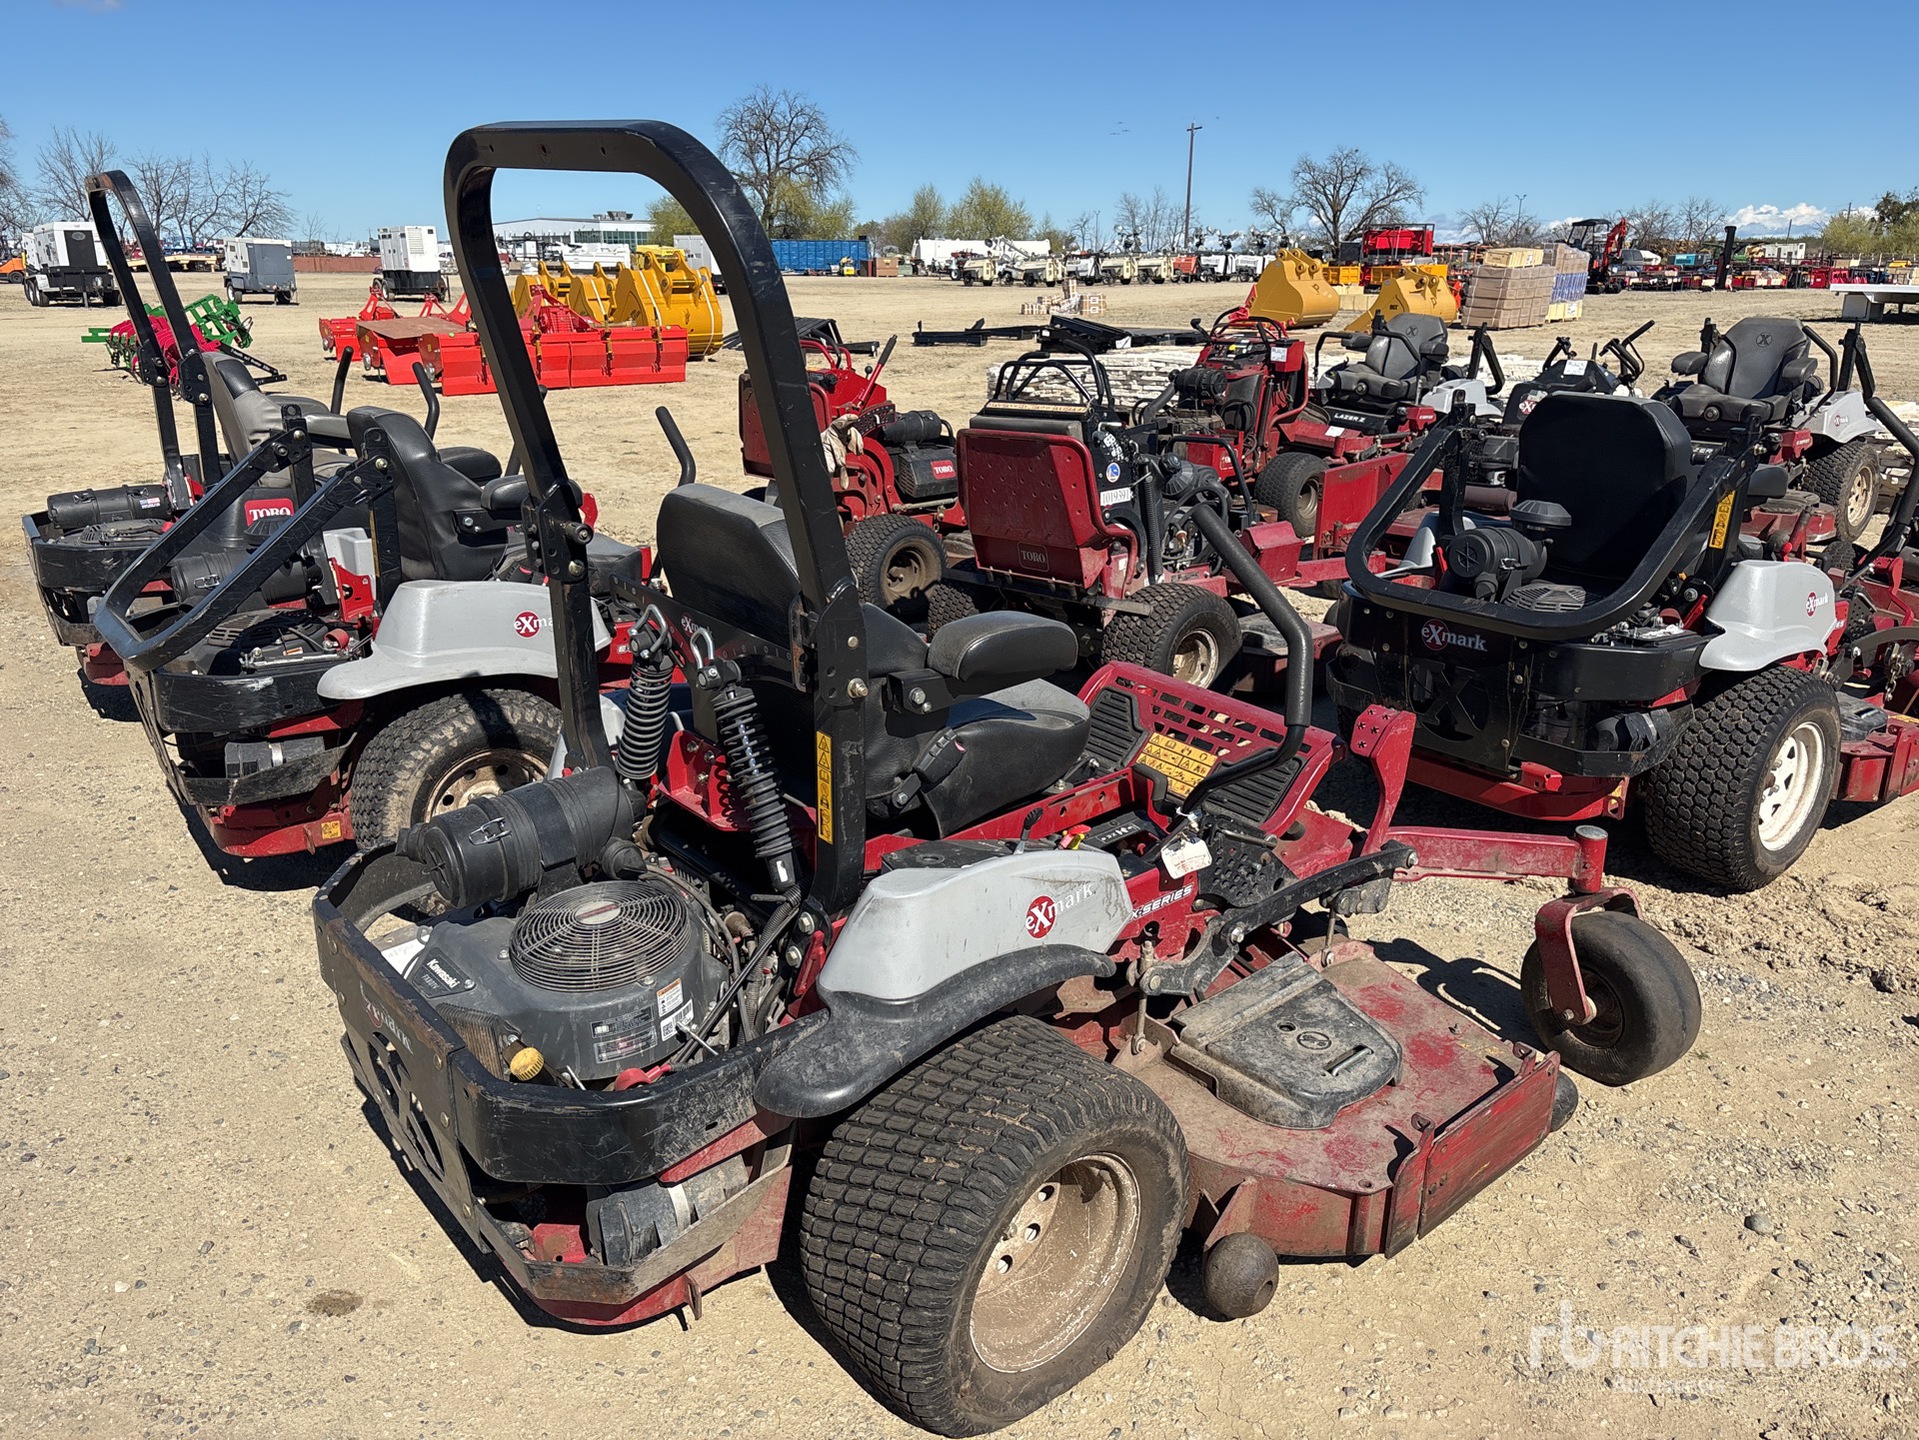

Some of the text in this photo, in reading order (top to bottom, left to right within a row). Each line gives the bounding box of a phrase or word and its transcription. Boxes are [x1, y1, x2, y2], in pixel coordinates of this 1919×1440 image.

[1334, 412, 1359, 422] LAZER
[934, 465, 954, 474] TORO
[1102, 488, 1130, 504] 1019391
[249, 506, 292, 522] TORO
[1021, 550, 1047, 563] TORO
[1806, 592, 1829, 613] eXmark
[513, 614, 554, 635] eXma
[1421, 623, 1488, 652] eXmark
[1025, 881, 1097, 935] eXmark
[427, 958, 461, 989] Kawasaki
